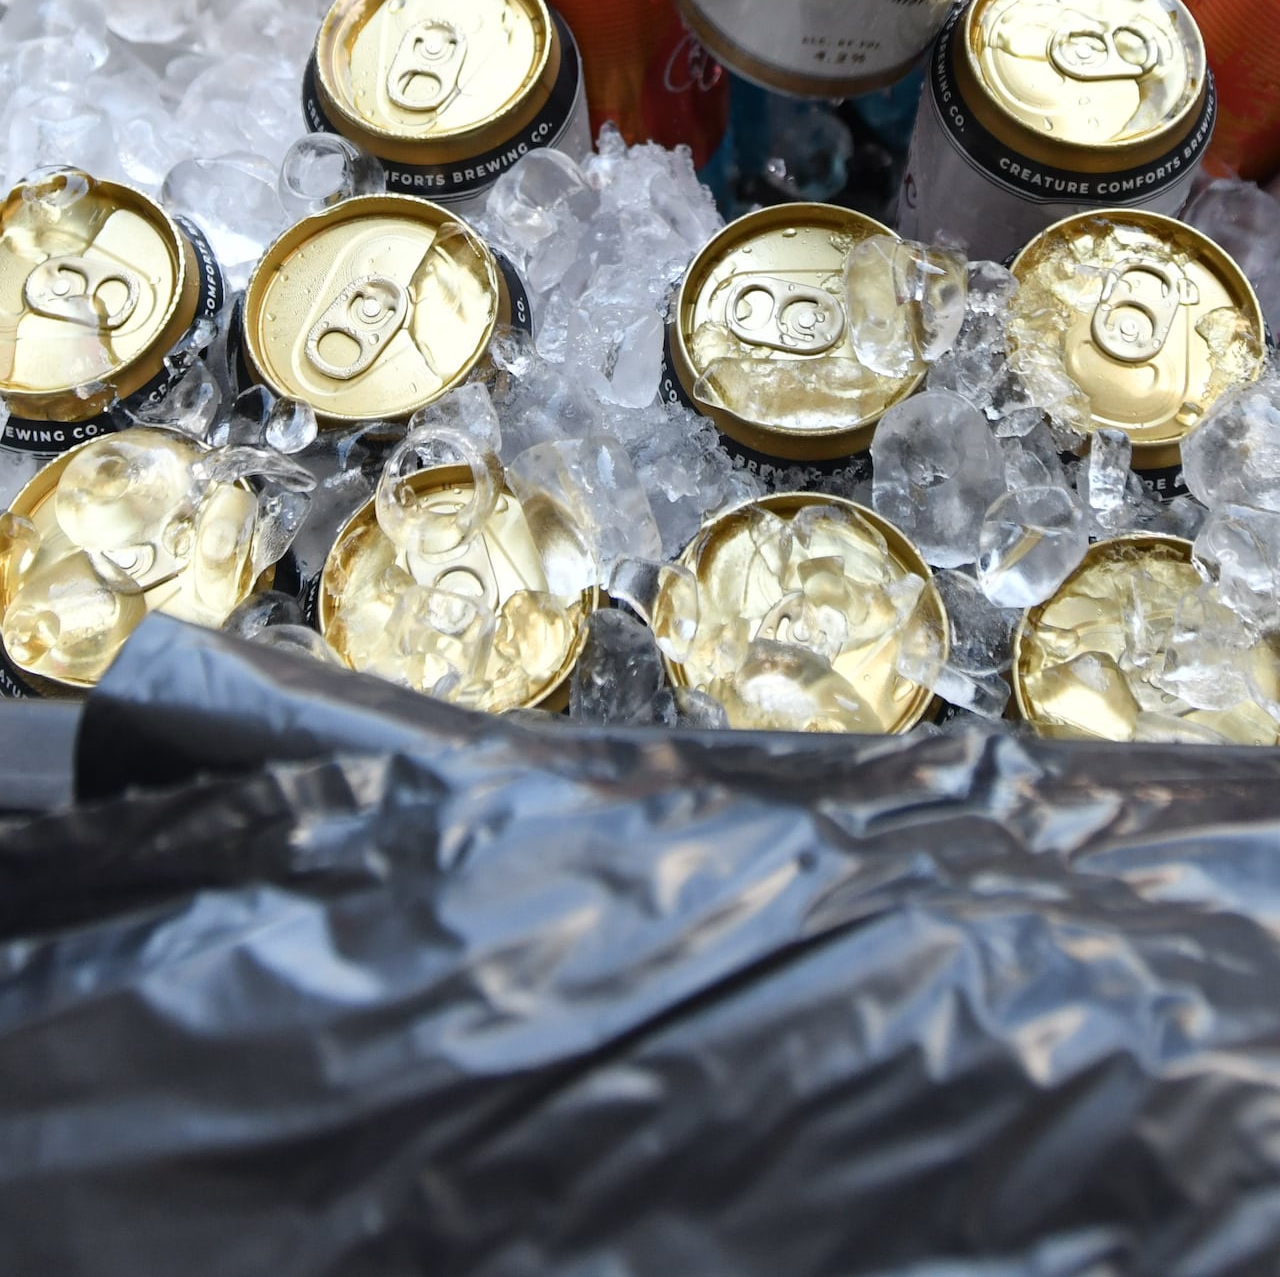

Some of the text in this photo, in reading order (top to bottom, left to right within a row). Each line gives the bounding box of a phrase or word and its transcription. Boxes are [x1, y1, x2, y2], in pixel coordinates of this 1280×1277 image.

[948, 104, 967, 134] CO.
[451, 141, 530, 184] BREWING
[529, 120, 554, 144] CO.
[999, 91, 1216, 196] CREATURE COMFORTS BREWING
[516, 297, 527, 324] CO.
[4, 423, 106, 442] EWING CO.
